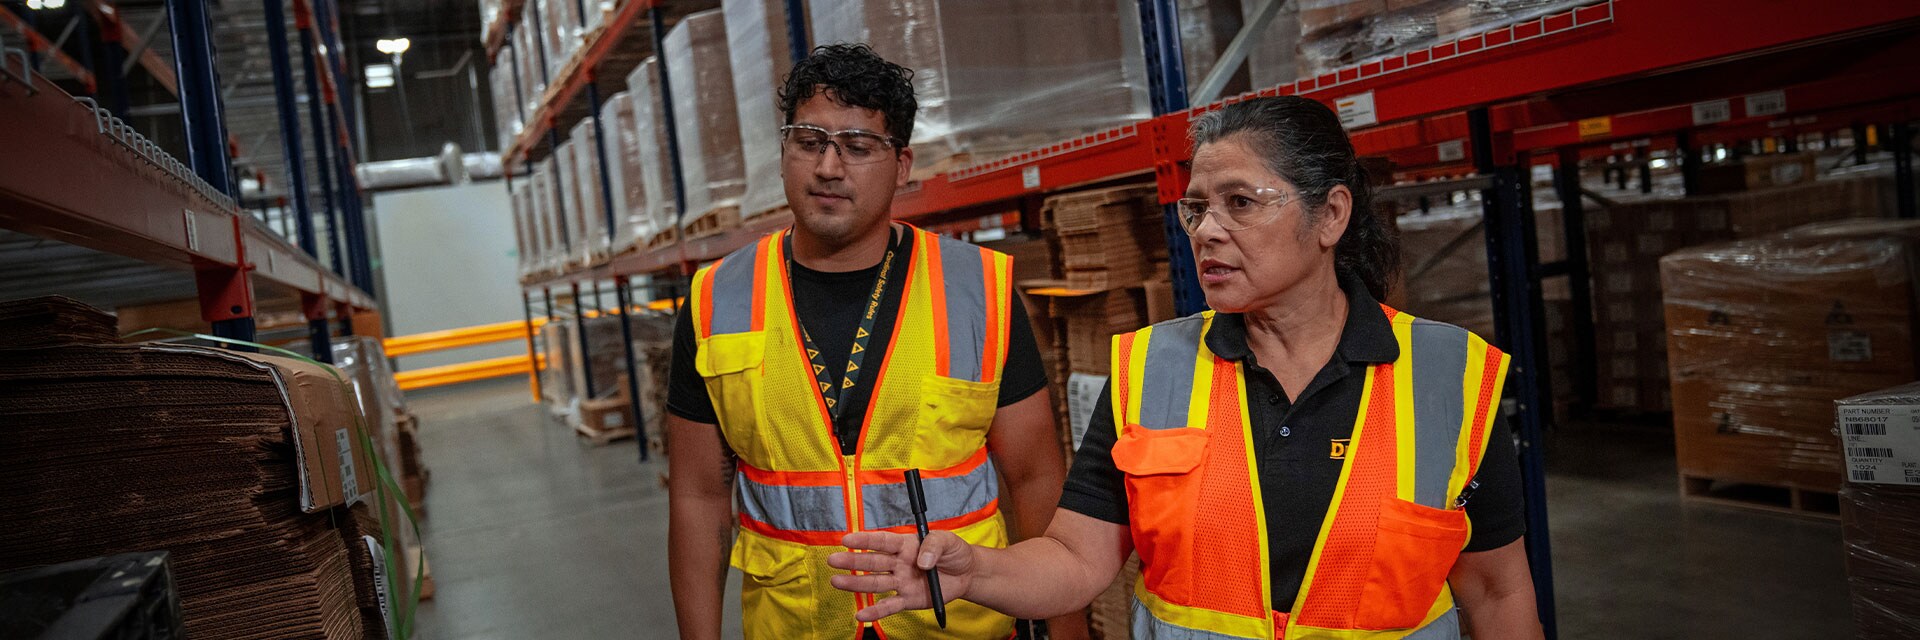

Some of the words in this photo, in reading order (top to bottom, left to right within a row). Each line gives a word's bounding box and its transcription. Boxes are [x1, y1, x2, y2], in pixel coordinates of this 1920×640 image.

[880, 250, 894, 279] Cardinal
[872, 279, 885, 300] Safety
[866, 301, 878, 320] Rules
